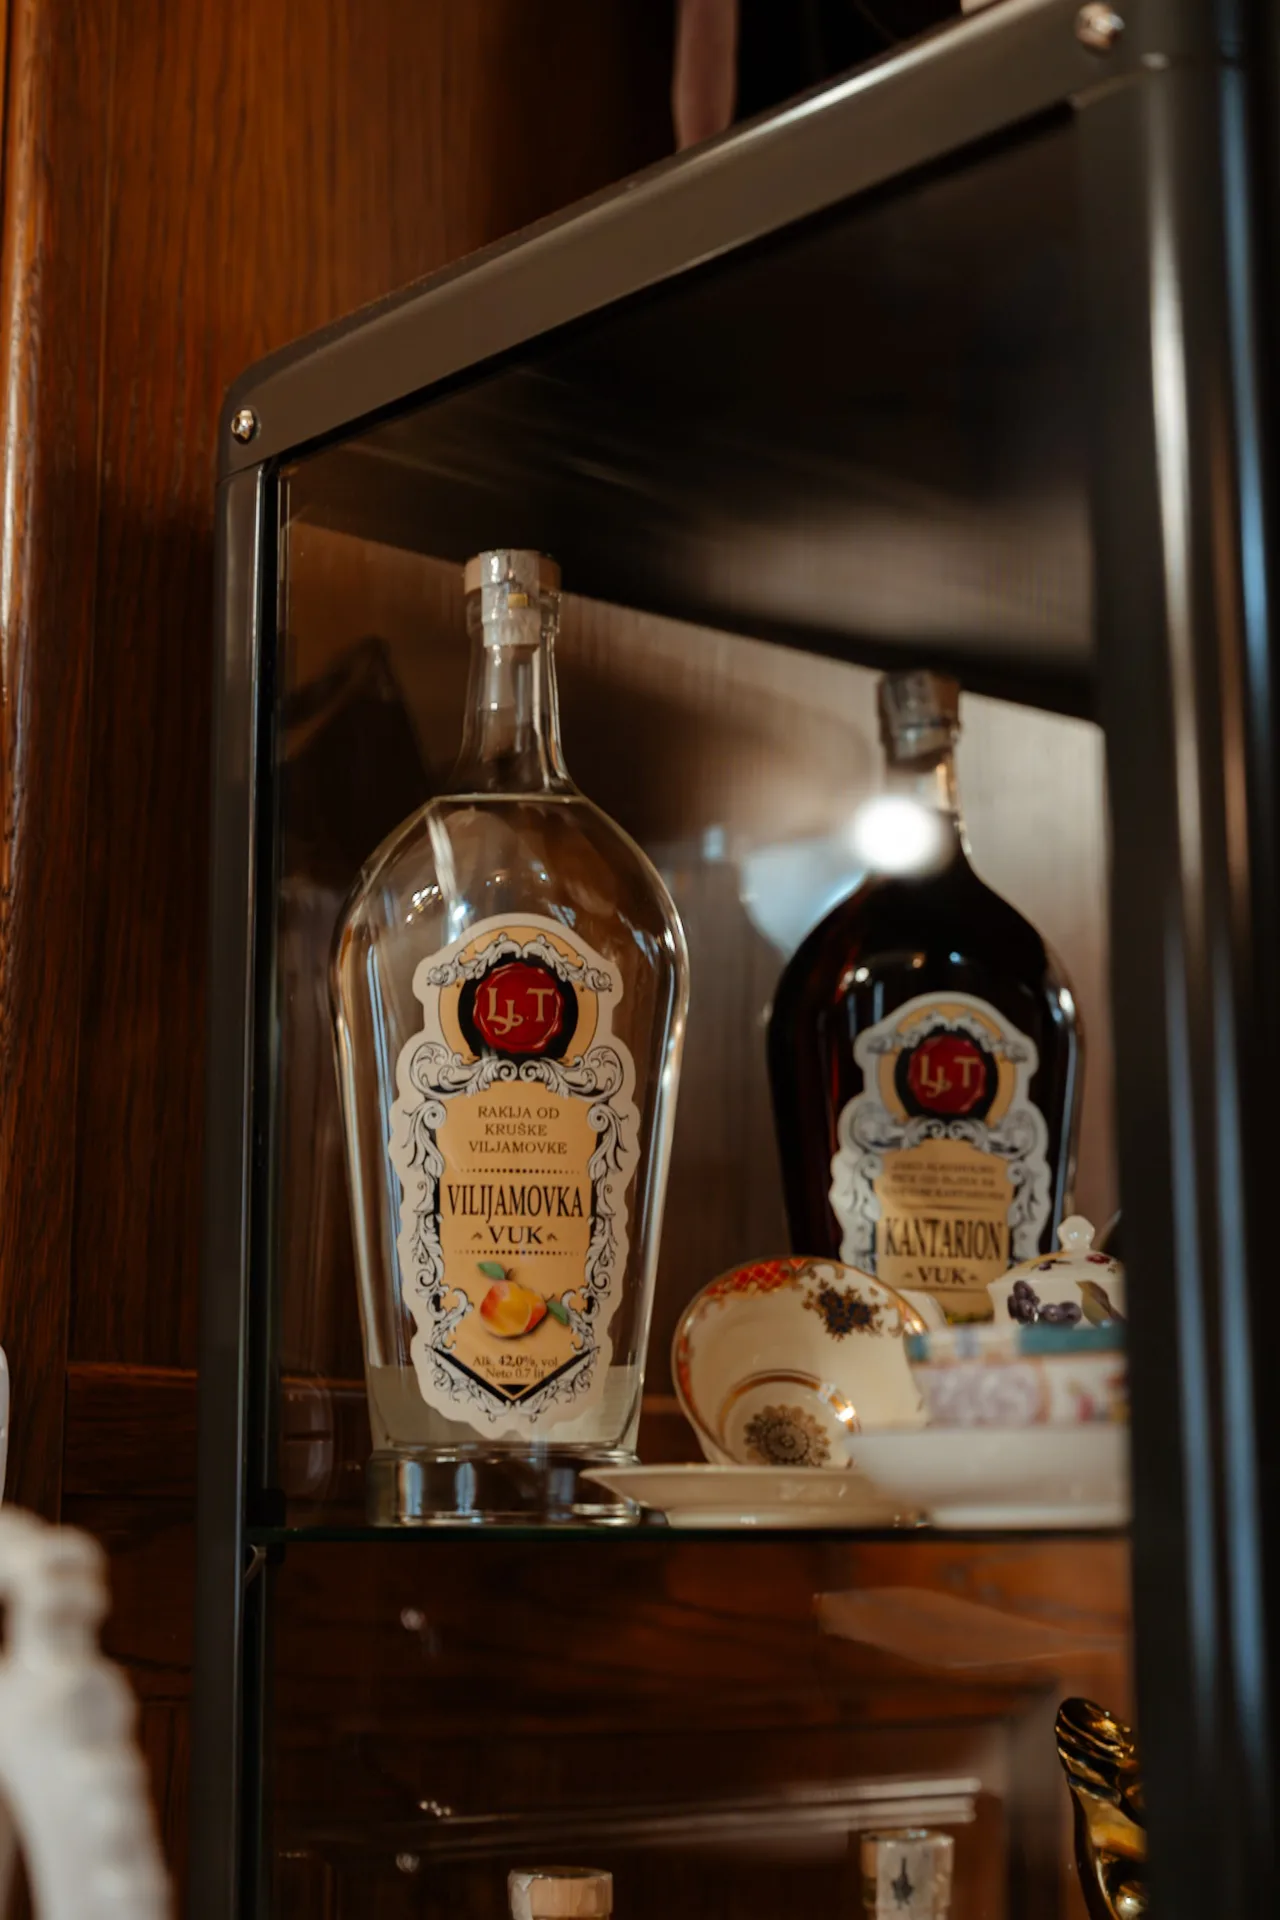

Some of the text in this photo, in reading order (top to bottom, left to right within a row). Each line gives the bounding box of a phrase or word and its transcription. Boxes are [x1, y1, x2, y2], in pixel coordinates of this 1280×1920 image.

[536, 1107, 560, 1119] OD
[468, 1140, 568, 1155] VILJAMOVKE
[447, 1184, 584, 1223] VILIJAMOVKA
[488, 1225, 543, 1245] VUK
[885, 1217, 1003, 1261] KANTARION
[917, 1265, 967, 1285] VUK
